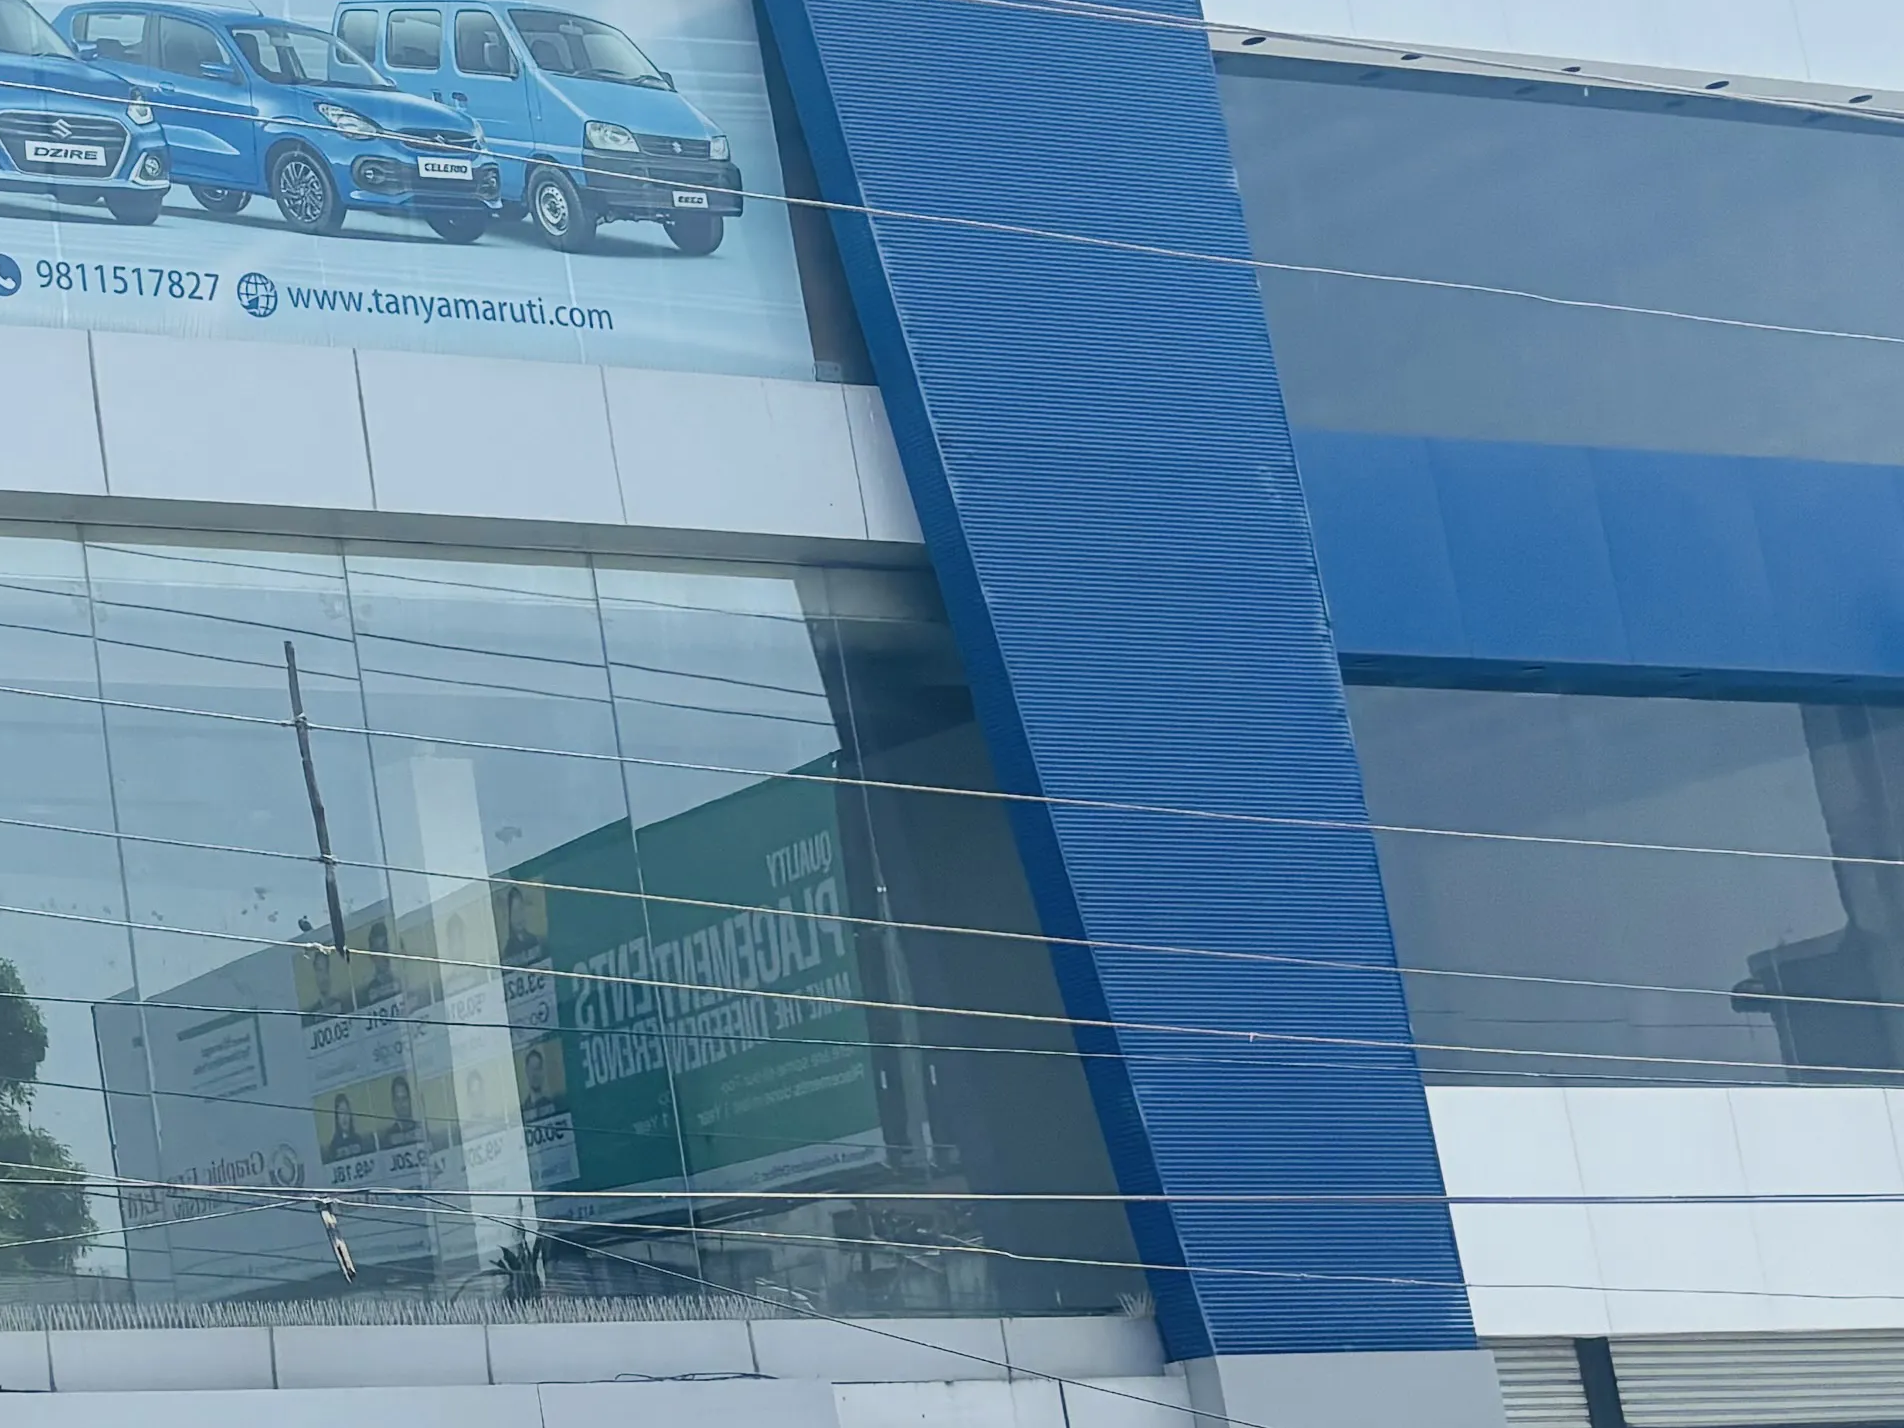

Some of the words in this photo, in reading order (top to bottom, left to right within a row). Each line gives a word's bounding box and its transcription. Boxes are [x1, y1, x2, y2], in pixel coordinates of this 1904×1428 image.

[32, 144, 99, 162] DZIRE
[423, 160, 470, 176] CELERIO
[35, 259, 220, 304] 9811517827
[286, 286, 615, 334] www.tanyamaruti.com
